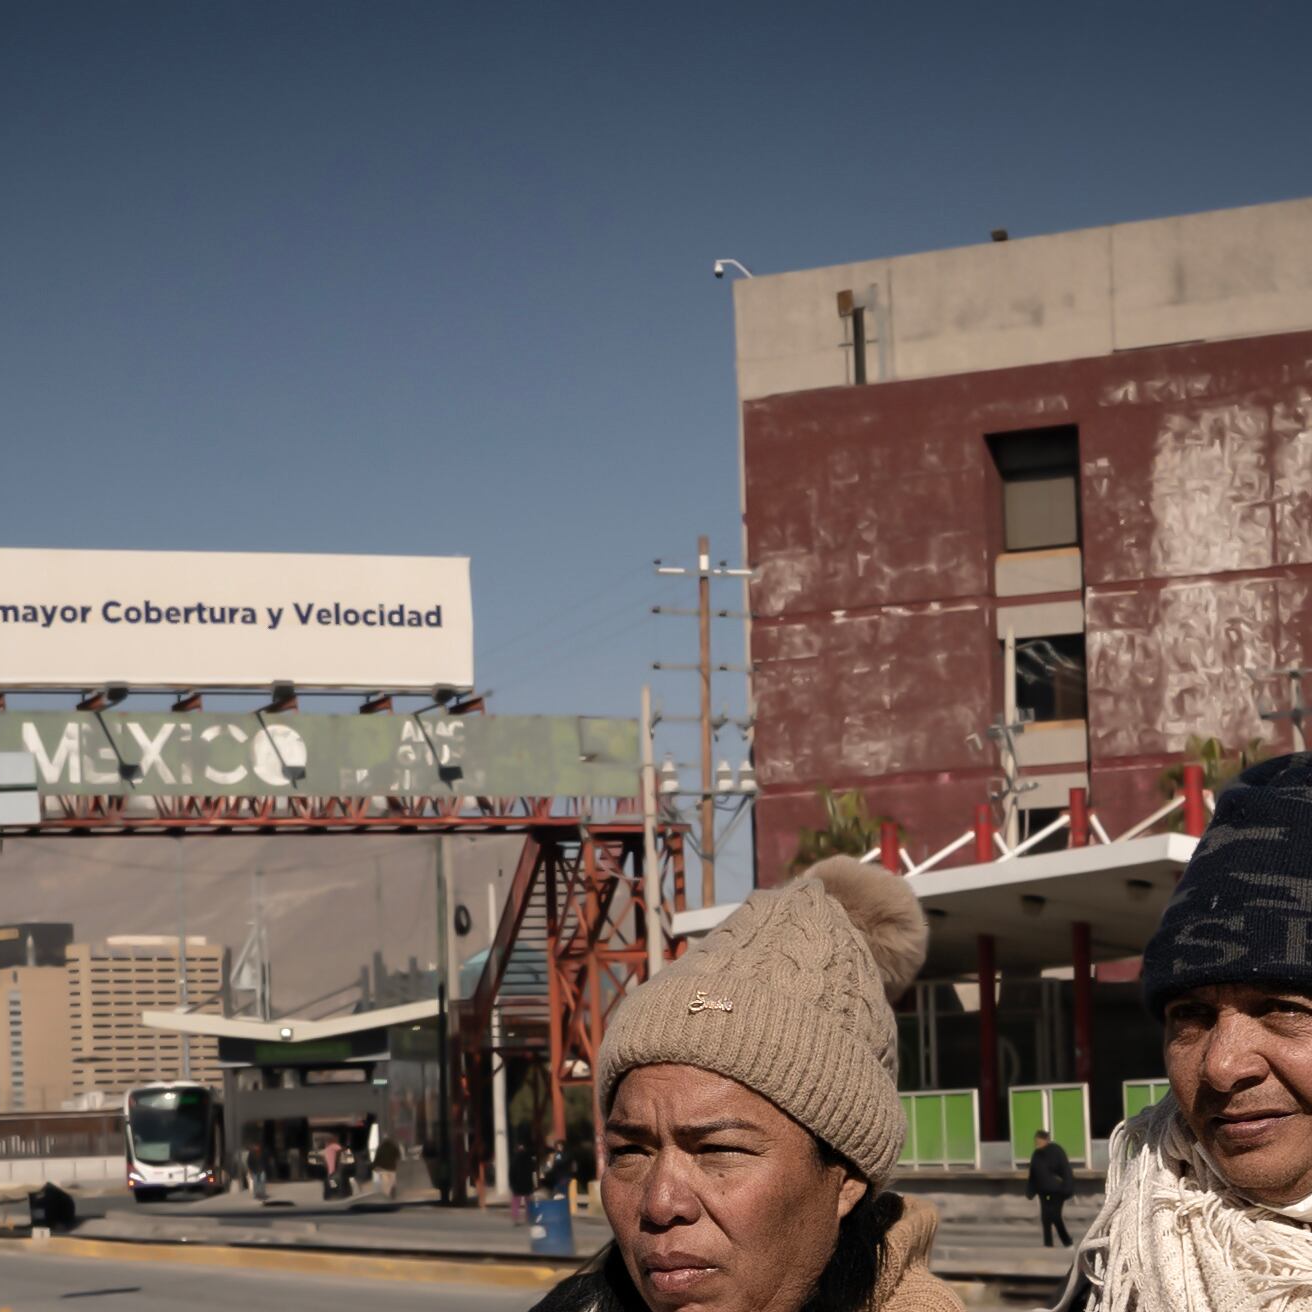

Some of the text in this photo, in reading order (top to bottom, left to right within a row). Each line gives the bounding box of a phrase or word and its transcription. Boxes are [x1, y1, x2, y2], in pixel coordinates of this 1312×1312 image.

[101, 600, 257, 625] Cobertura
[267, 608, 284, 630] y
[294, 602, 443, 628] Velocidad
